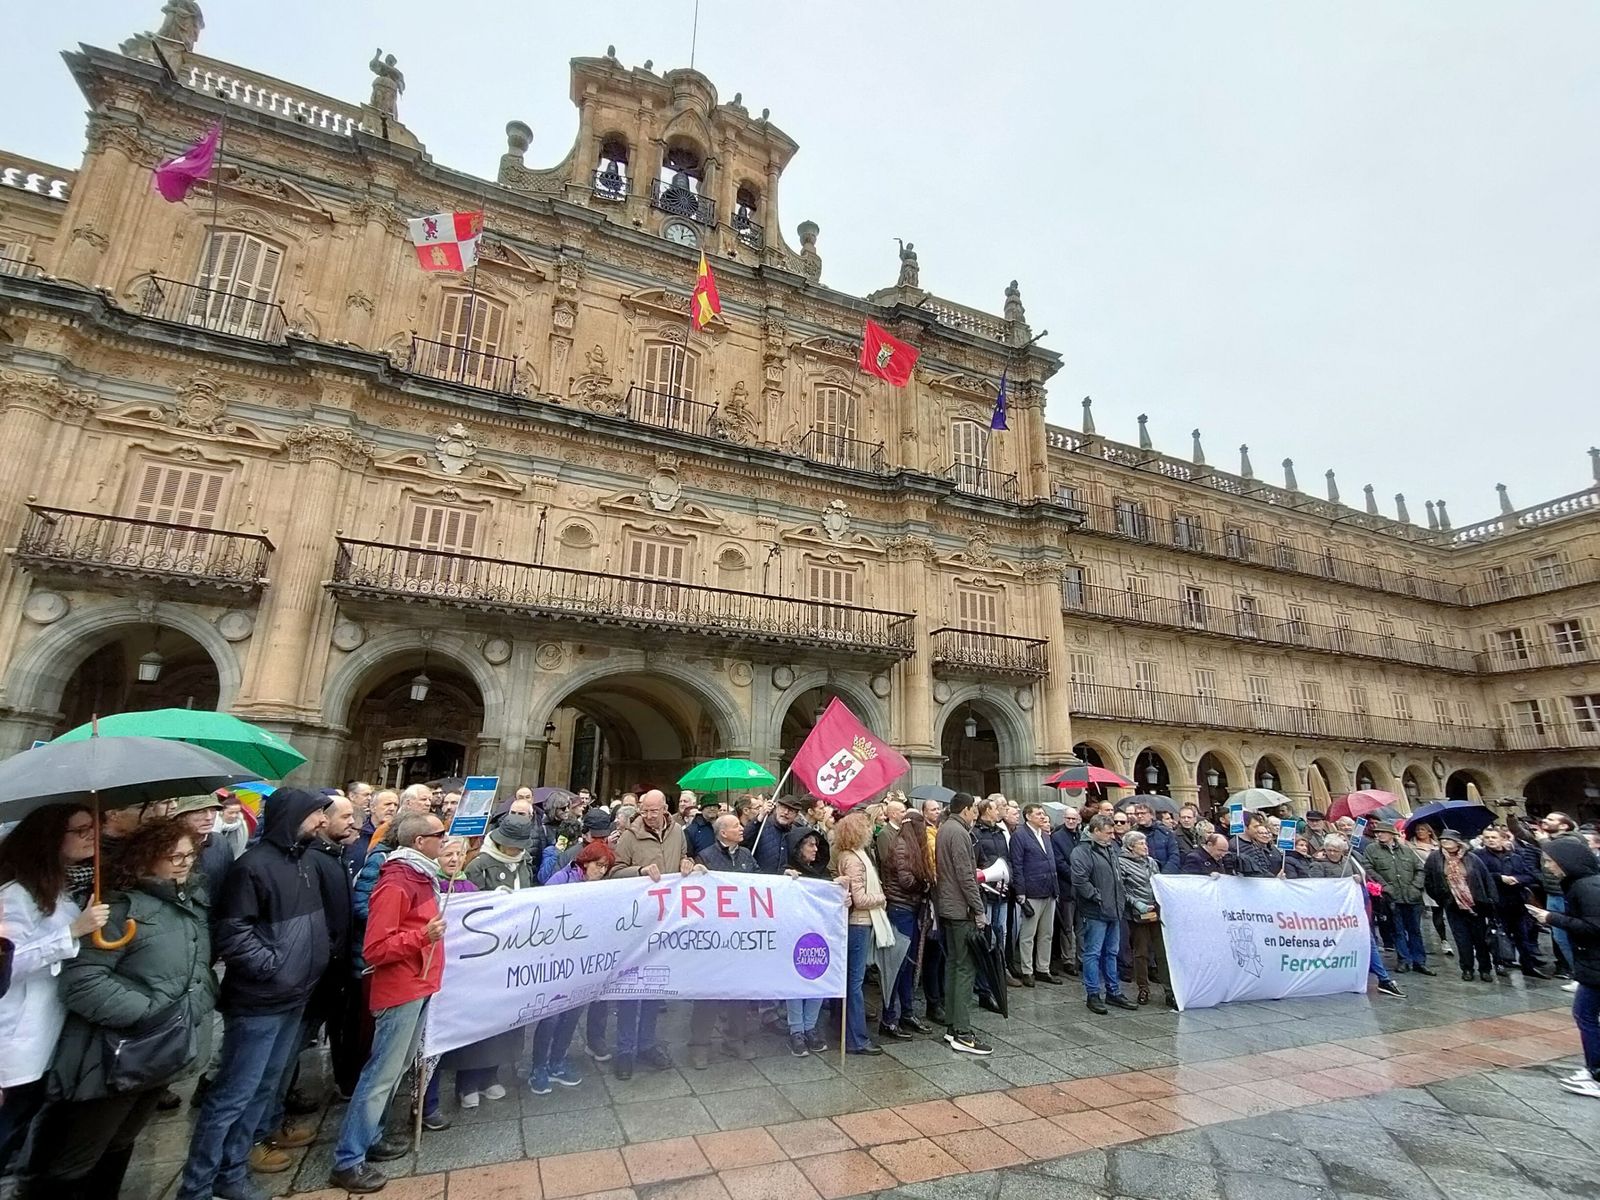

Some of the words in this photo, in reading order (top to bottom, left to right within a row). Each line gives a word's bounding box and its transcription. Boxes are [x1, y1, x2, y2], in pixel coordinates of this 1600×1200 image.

[615, 899, 643, 932] al
[647, 885, 775, 922] TREN
[1222, 909, 1274, 923] Plataforma
[1277, 911, 1359, 931] Salmantina
[647, 930, 721, 953] PROGRESO
[730, 930, 777, 951] OESTE
[799, 947, 828, 958] PODEMOS
[1264, 936, 1277, 947] en
[1279, 935, 1321, 949] Defensa
[506, 953, 575, 989] MOVILIDAD
[580, 950, 622, 976] VERDE
[796, 955, 829, 966] SALAMANCA
[1280, 950, 1358, 972] Ferrocarril
